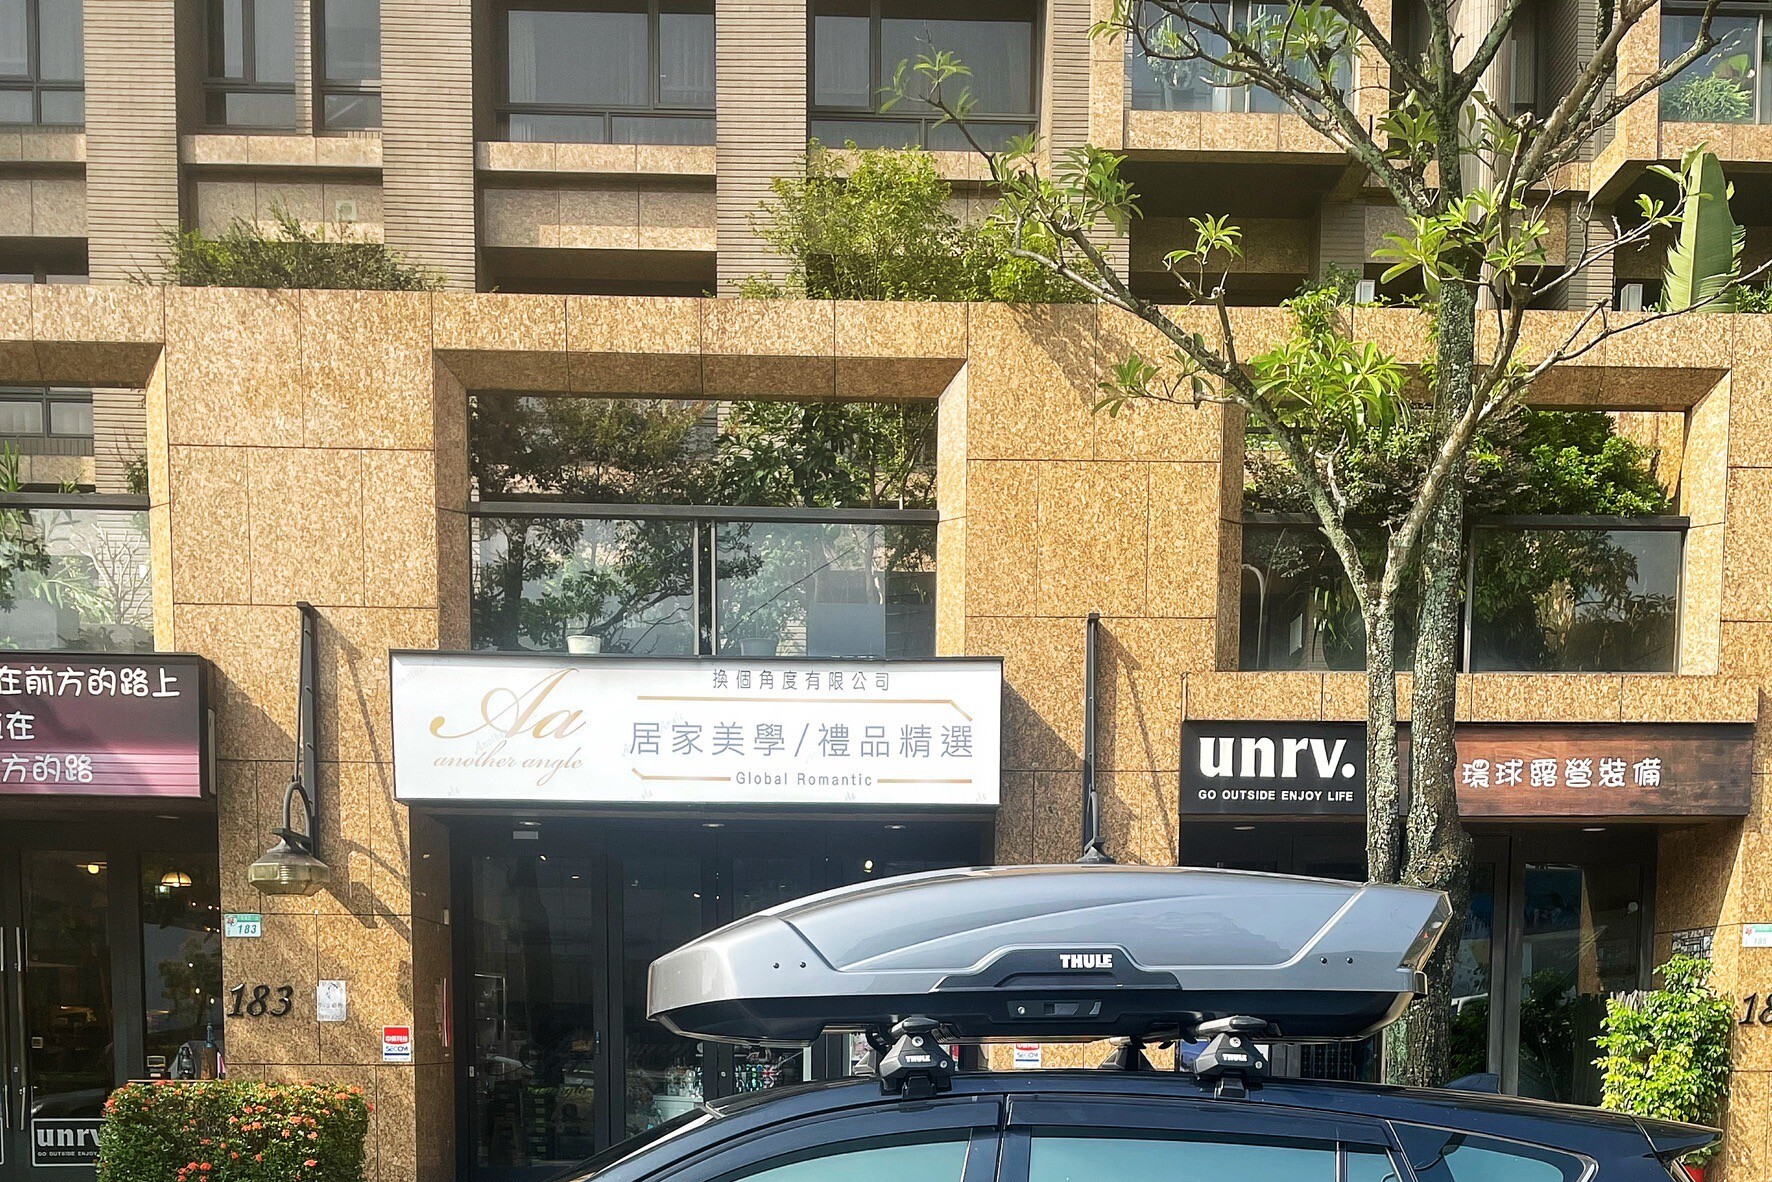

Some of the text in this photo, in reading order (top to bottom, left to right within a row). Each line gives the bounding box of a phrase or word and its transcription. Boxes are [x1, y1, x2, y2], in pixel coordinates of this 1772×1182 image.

[0, 665, 181, 697] 在前方的路上
[712, 668, 889, 691] 換個角度有限公司
[429, 667, 587, 739] Aa
[0, 711, 35, 740] 在
[629, 721, 973, 759] 居家美學/禮品精選
[2, 753, 93, 783] 方的路
[433, 740, 517, 768] another
[521, 747, 583, 787] angle
[1199, 737, 1356, 779] unrv.
[735, 771, 872, 786] Global Romantic
[1461, 757, 1662, 789] 環球露營裝備
[1198, 789, 1354, 802] GO OUTSIDE ENJOY LIFE
[237, 924, 257, 935] 183
[1059, 953, 1113, 969] THULE
[226, 983, 294, 1017] 183
[905, 1054, 932, 1063] THULE
[1222, 1053, 1248, 1062] THULE
